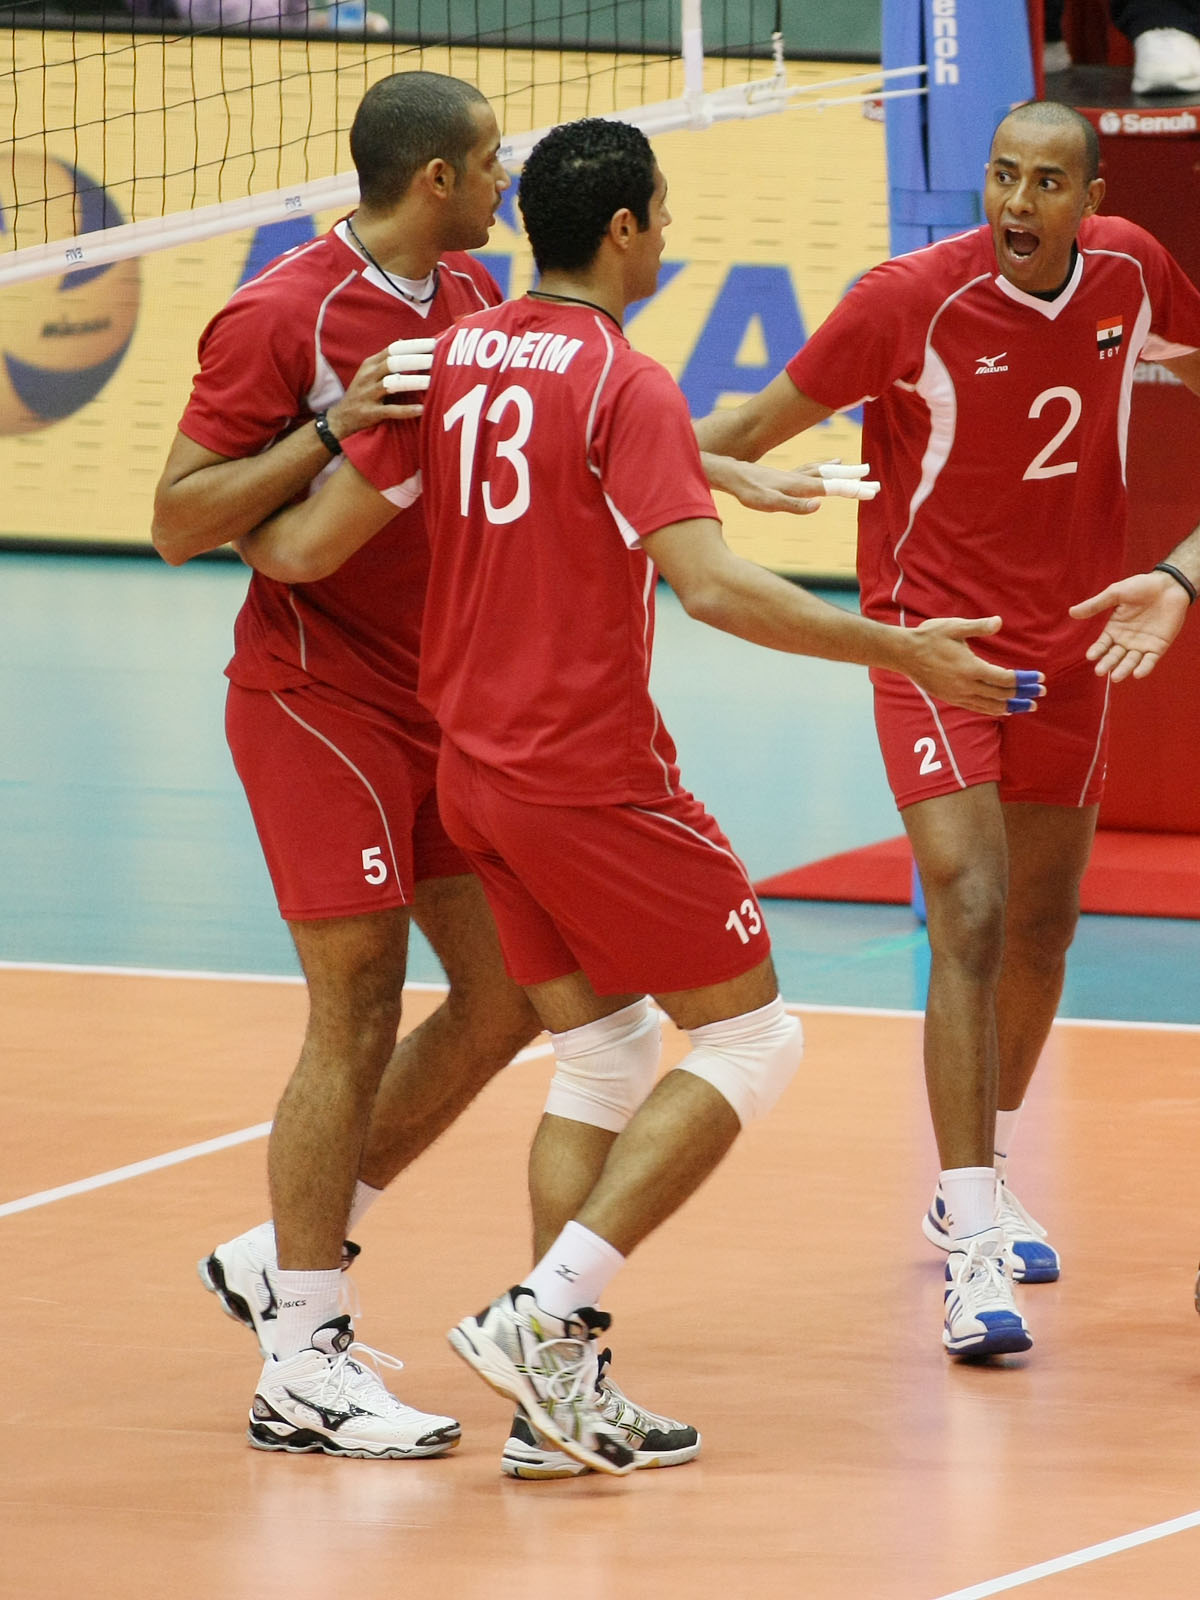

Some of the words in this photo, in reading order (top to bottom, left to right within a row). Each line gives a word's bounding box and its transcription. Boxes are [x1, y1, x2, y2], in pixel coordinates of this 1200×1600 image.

[1122, 111, 1197, 134] Senoh
[1099, 346, 1120, 360] EGY
[1022, 386, 1082, 481] 2
[443, 383, 534, 525] 13
[913, 736, 942, 776] 2
[361, 846, 388, 885] 5
[725, 898, 762, 945] 13
